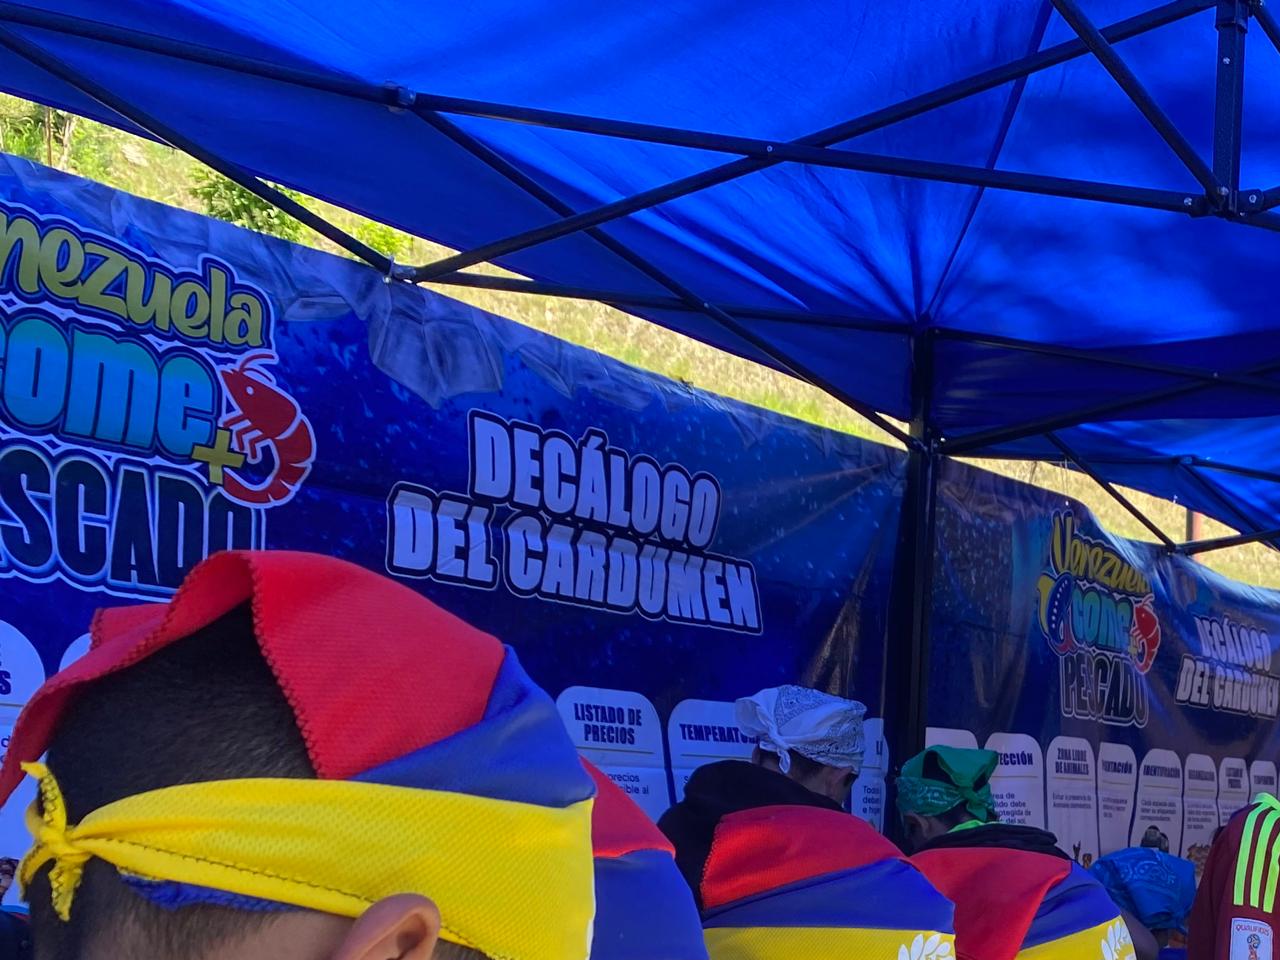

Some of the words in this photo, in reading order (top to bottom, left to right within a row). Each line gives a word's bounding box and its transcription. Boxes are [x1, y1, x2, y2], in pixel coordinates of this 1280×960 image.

[0, 318, 216, 455] ome
[474, 416, 717, 546] DECÁLOGO
[393, 492, 496, 583] DEL
[508, 516, 758, 628] CARDUMEN
[574, 702, 625, 724] LISTADO
[628, 708, 642, 727] DE
[1176, 658, 1210, 705] DEL
[1213, 665, 1280, 717] CARDUMEN
[584, 724, 635, 745] PRECIOS
[1000, 750, 1034, 766] ECCIÓN
